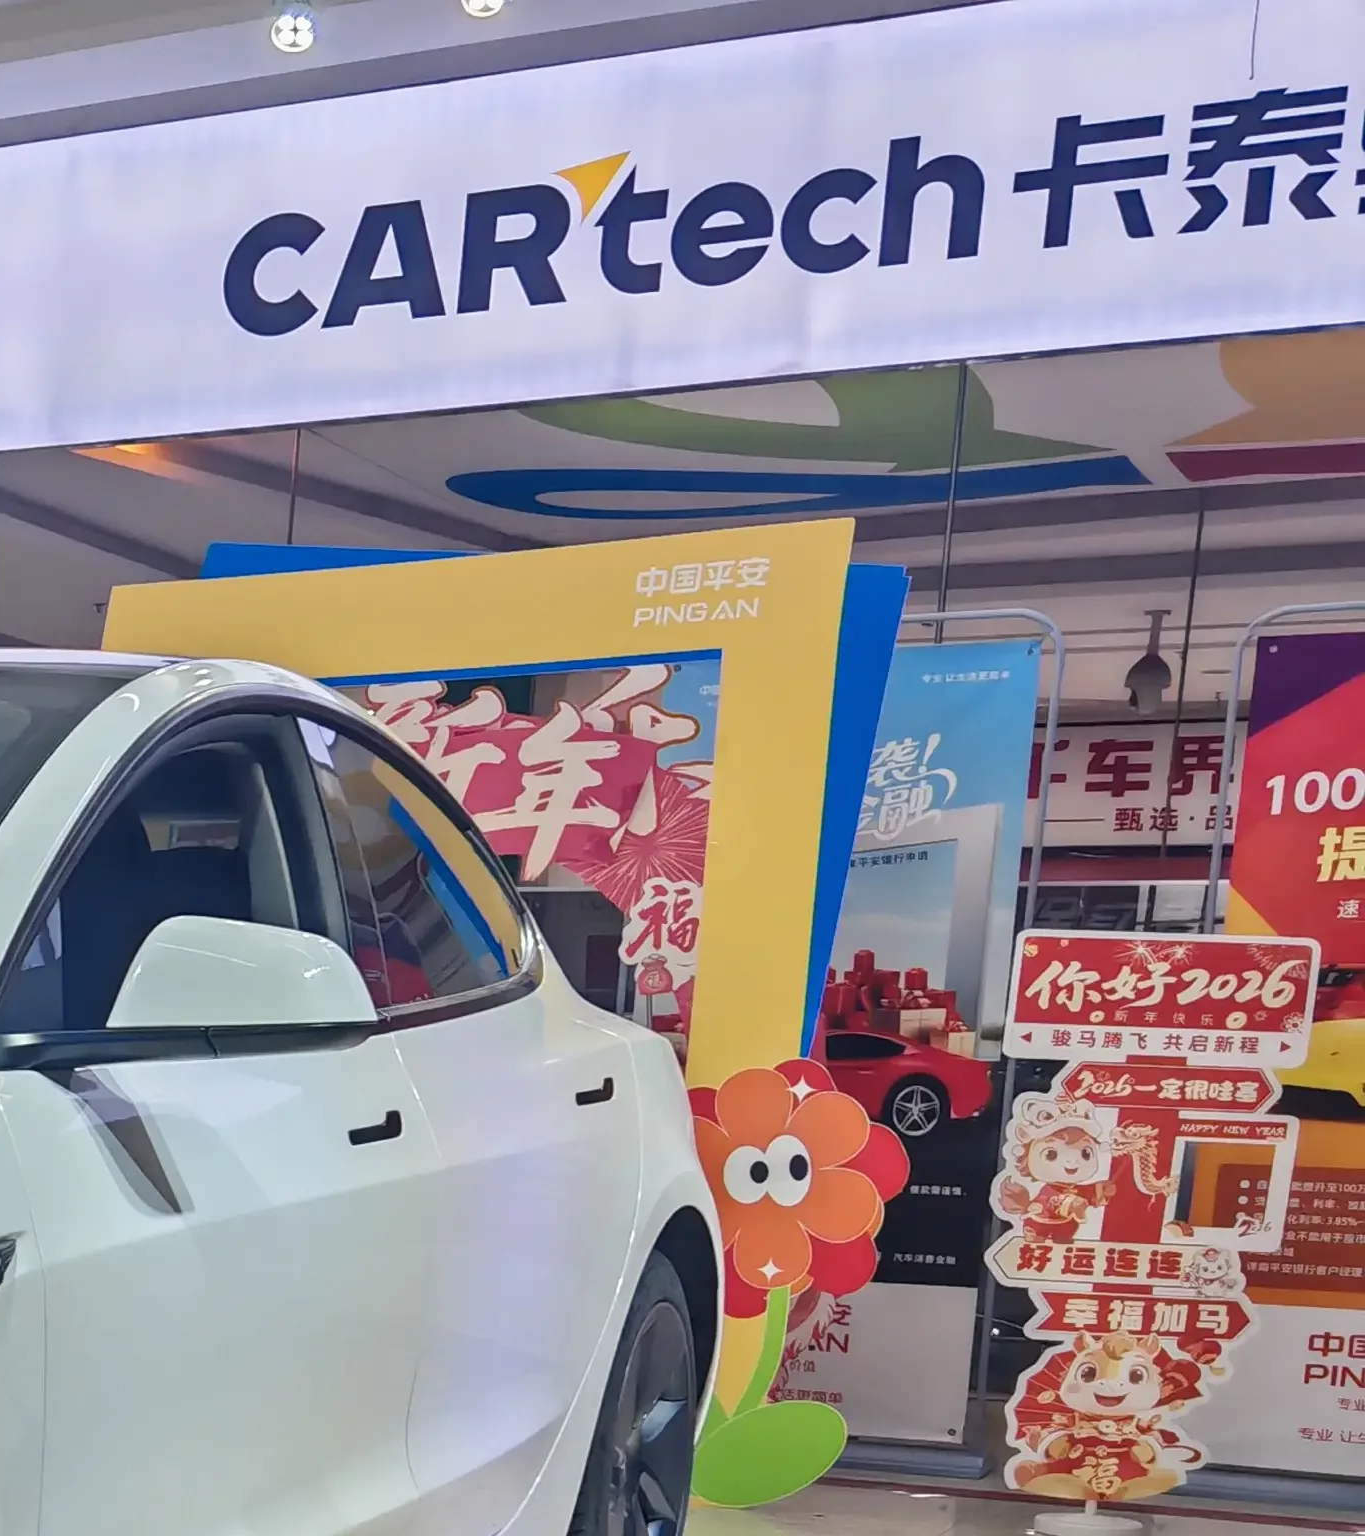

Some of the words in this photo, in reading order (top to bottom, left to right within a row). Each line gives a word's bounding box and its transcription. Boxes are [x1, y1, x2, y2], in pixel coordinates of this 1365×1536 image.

[222, 134, 986, 338] CARtech
[1012, 86, 1365, 248] 卡泰
[635, 556, 771, 598] 中国平安
[625, 884, 701, 959] 福
[1113, 1010, 1214, 1027] 新年快乐
[1051, 1029, 1148, 1050] 骏马腾飞
[1162, 1033, 1260, 1054] 共启新程
[1180, 1123, 1219, 1134] HAPPY
[1222, 1124, 1248, 1136] NEW
[1254, 1126, 1287, 1138] YEAR
[1017, 1244, 1183, 1280] 好运连连
[1062, 1298, 1232, 1335] 幸福加马
